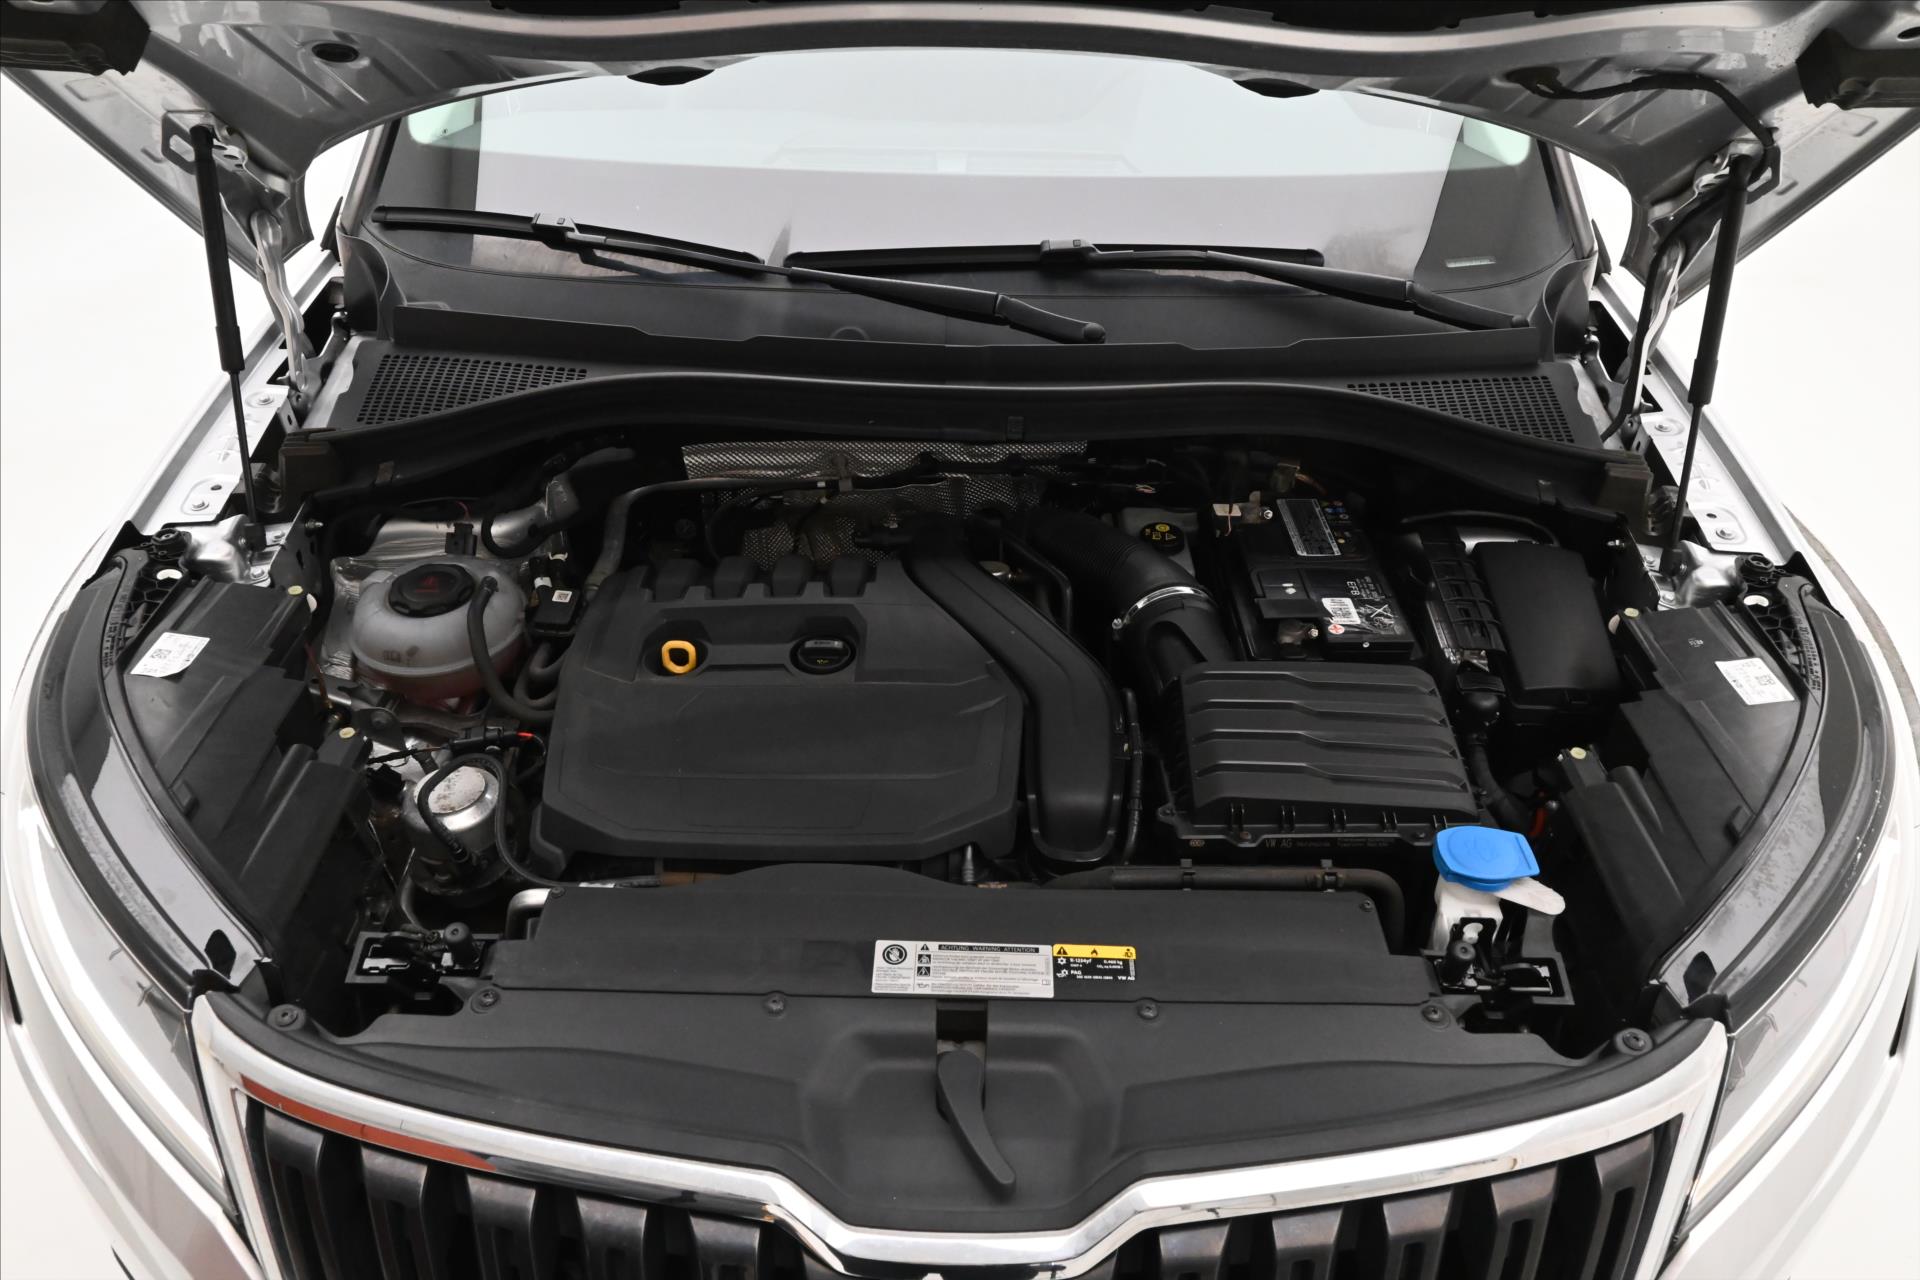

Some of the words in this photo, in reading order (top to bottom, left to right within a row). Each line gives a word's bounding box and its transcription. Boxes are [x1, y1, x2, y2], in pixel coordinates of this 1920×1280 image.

[1346, 581, 1360, 596] EFB
[1265, 839, 1276, 848] VW
[1280, 838, 1293, 848] AG
